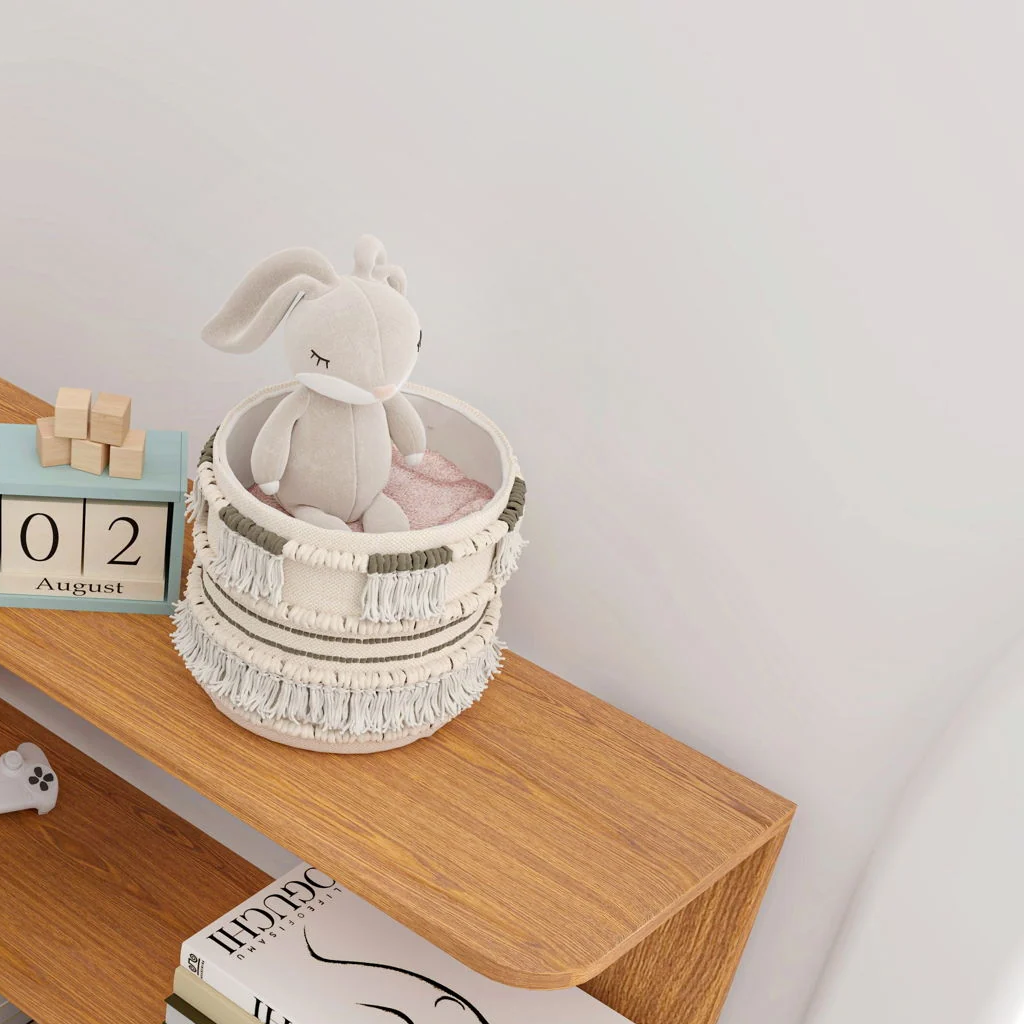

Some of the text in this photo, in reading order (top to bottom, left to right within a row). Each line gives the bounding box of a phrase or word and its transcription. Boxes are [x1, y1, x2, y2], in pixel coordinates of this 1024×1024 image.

[36, 577, 124, 596] August
[207, 867, 336, 955] OGUCHI
[237, 887, 342, 961] LIFE OF ISAMU
